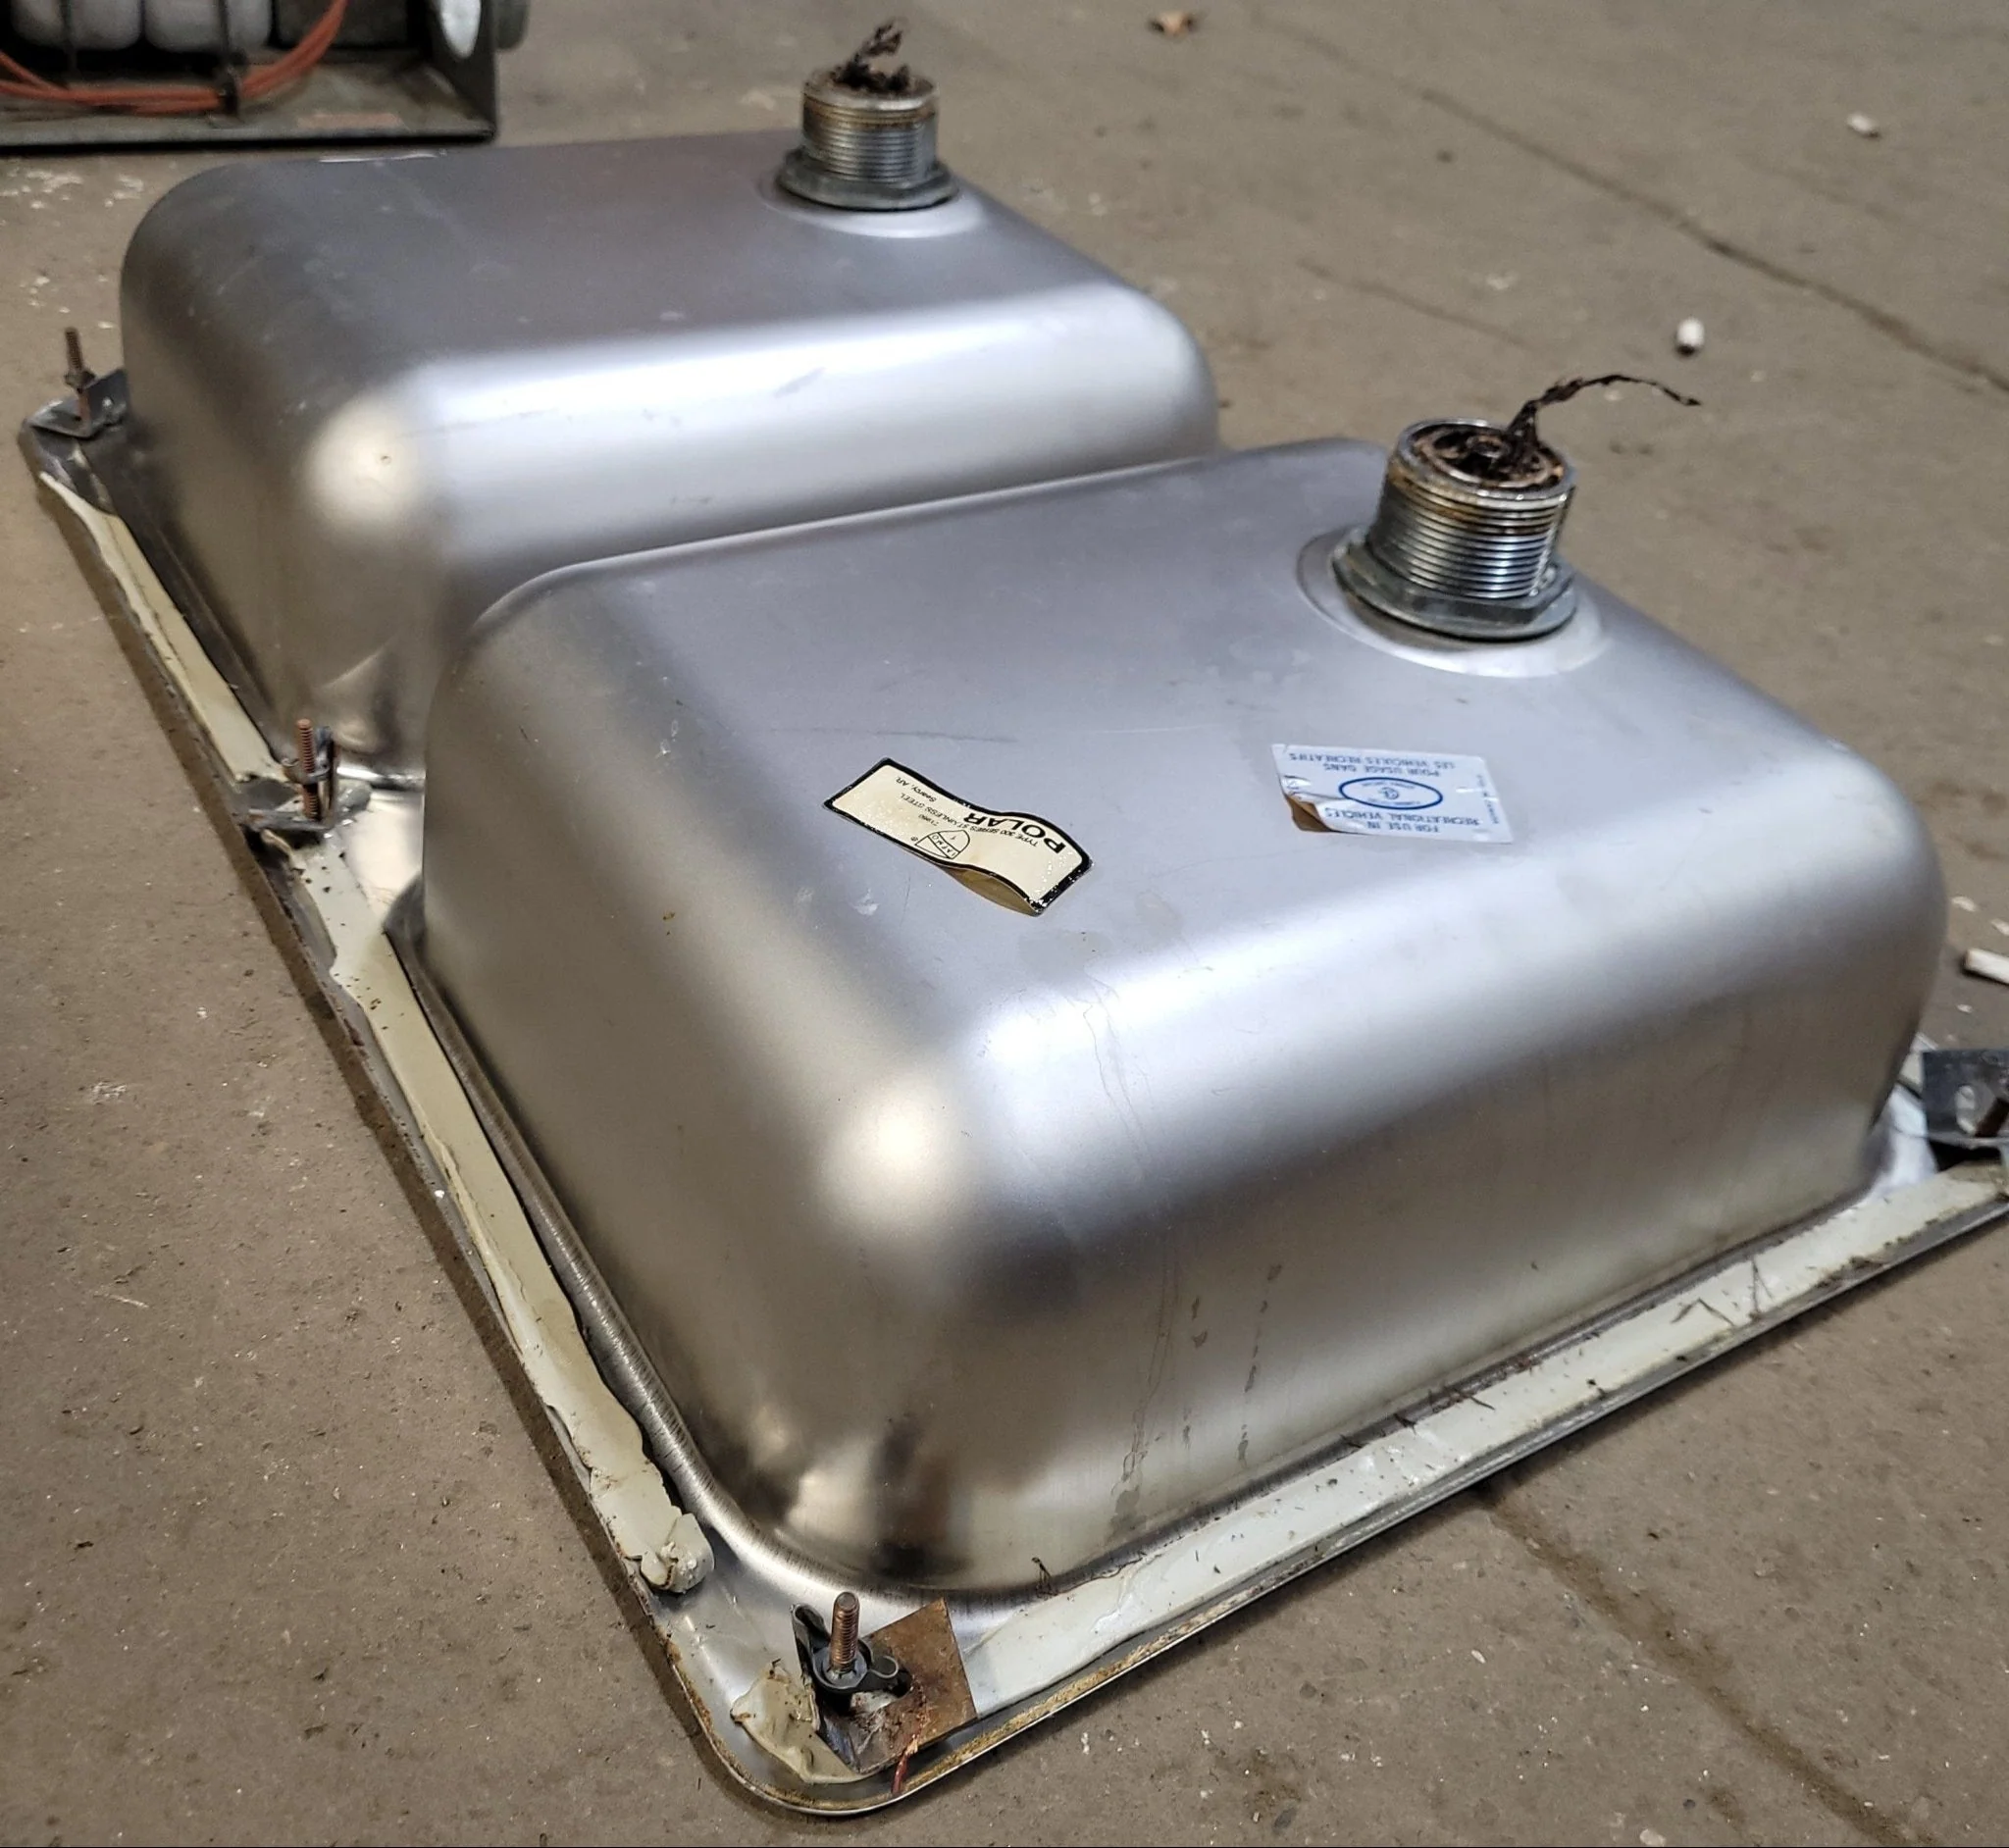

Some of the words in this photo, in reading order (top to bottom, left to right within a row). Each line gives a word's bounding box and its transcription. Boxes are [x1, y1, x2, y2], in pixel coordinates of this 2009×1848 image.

[1325, 807, 1381, 820] VEHICLES
[1387, 813, 1480, 825] RECREATIONAL
[963, 812, 1066, 853] POLAR
[1388, 822, 1412, 831] USE
[1415, 823, 1439, 833] FOR
[1015, 834, 1039, 847] TYPE
